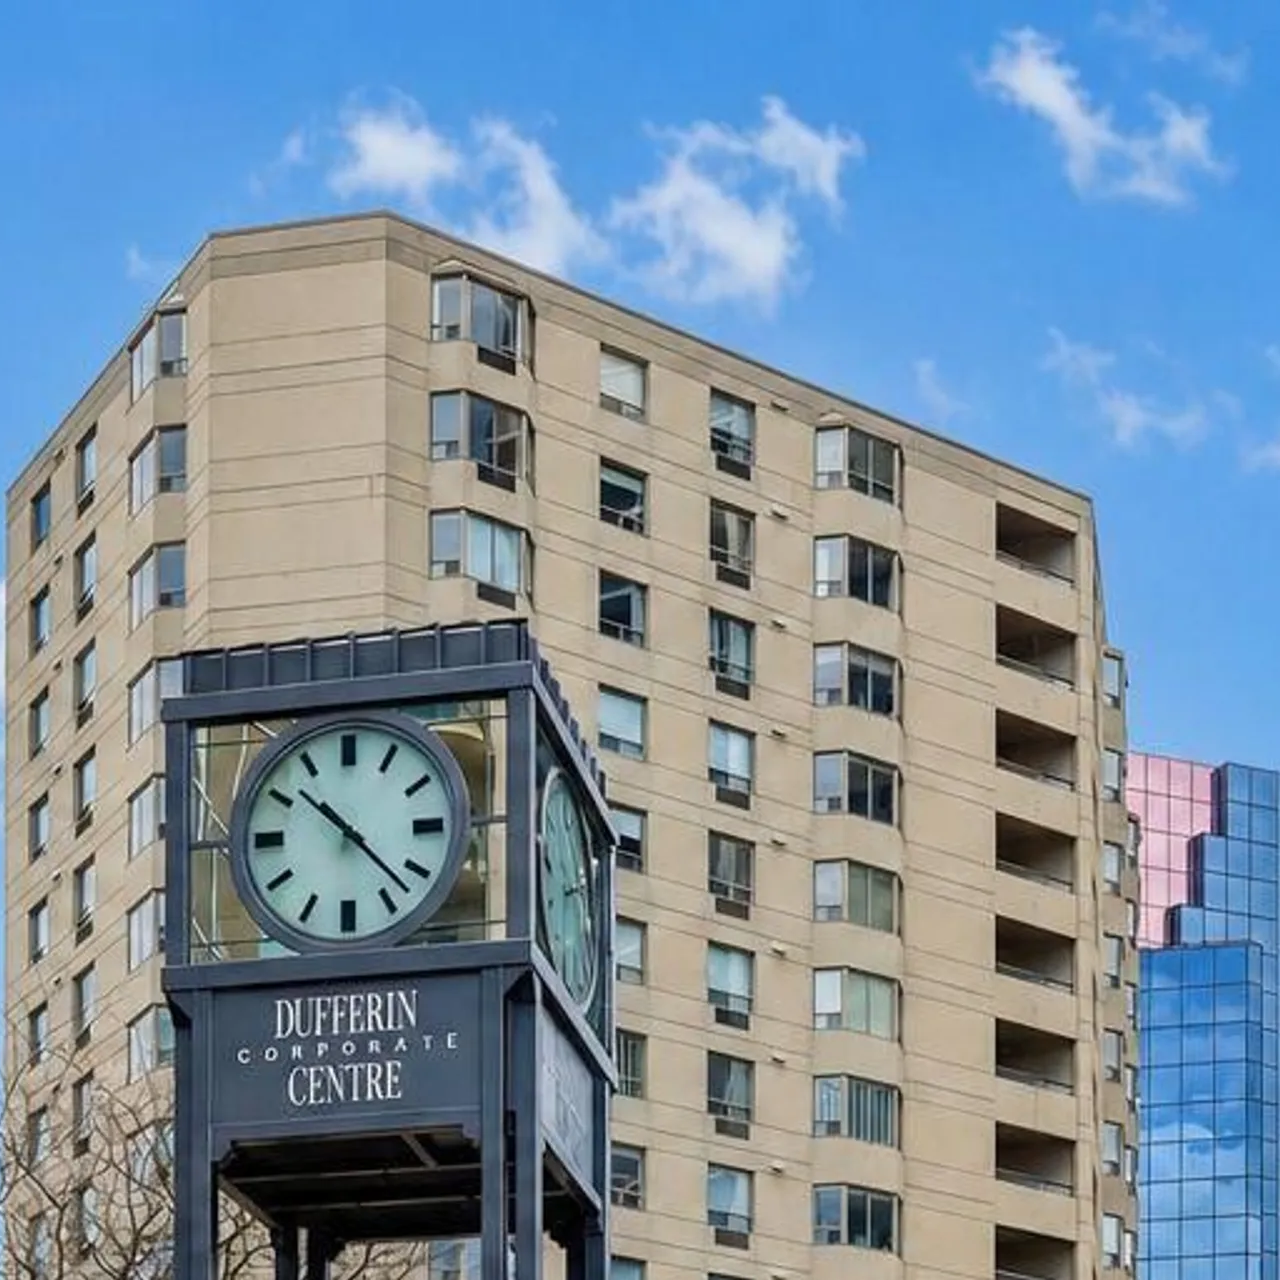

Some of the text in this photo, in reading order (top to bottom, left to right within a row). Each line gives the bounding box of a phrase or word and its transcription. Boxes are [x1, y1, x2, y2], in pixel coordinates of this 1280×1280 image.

[275, 990, 418, 1039] DUFFERIN
[237, 1032, 458, 1064] CORPORATE
[288, 1060, 402, 1106] CENTRE
